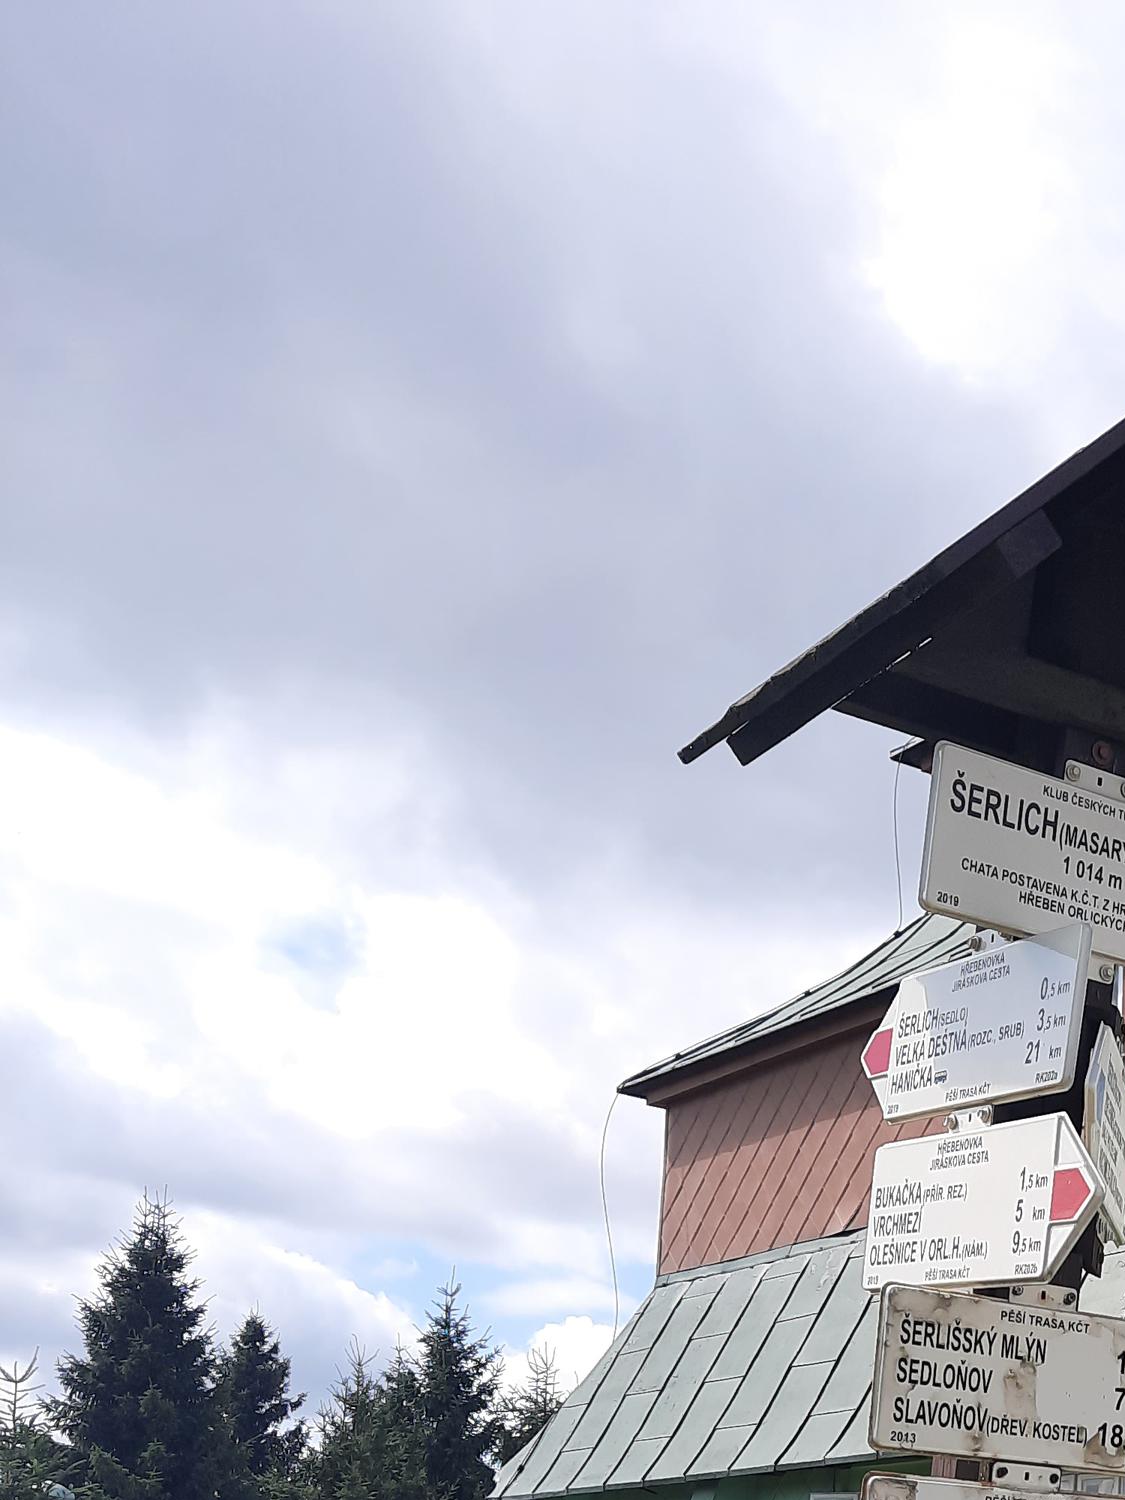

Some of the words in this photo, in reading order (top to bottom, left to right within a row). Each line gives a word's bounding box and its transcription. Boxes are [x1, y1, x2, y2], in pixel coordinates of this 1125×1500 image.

[1043, 785, 1068, 802] KLUB
[1071, 793, 1116, 817] ČESKÝCH
[961, 857, 999, 879] CHATA
[1002, 870, 1068, 900] POSTAVENA
[1102, 899, 1110, 910] Z
[1108, 871, 1122, 890] m
[937, 891, 959, 906] 2019
[1019, 890, 1065, 914] HŘEBEN
[1040, 977, 1055, 999] 0,5
[1057, 982, 1070, 995] km
[895, 1038, 925, 1066] VELKÁ
[998, 1020, 1024, 1043] SRUB)
[1037, 1008, 1051, 1032] 3,5
[1053, 1015, 1066, 1028] km
[891, 1064, 933, 1095] HANIČKA
[1024, 1040, 1040, 1064] 21
[1049, 1046, 1061, 1059] km
[959, 1085, 978, 1100] TRASA
[937, 1136, 983, 1155] HŘEBENOVKA
[967, 1151, 989, 1165] CESTA
[946, 1183, 967, 1201] REZ.)
[1020, 1167, 1035, 1191] 1,5
[1036, 1175, 1048, 1188] km
[873, 1207, 922, 1237] VRCHMEZÍ
[1015, 1199, 1023, 1222] 5
[1033, 1208, 1045, 1221] km
[869, 1237, 917, 1266] OLEŠNICE
[920, 1239, 927, 1260] V
[1012, 1230, 1027, 1253] 9,5
[1028, 1238, 1041, 1251] km
[939, 1269, 958, 1279] TRASA
[959, 1267, 970, 1278] KČT
[1001, 1310, 1026, 1324] PĚŠÍ
[1028, 1315, 1065, 1331] TRASA
[1068, 1320, 1090, 1334] KČT
[900, 1314, 997, 1356] ŠERLIŠSKÝ
[1001, 1332, 1047, 1364] MLÝN
[896, 1358, 993, 1394] SEDLOŇOV
[891, 1431, 916, 1444] 2013
[1032, 1420, 1088, 1445] KOSTEL)
